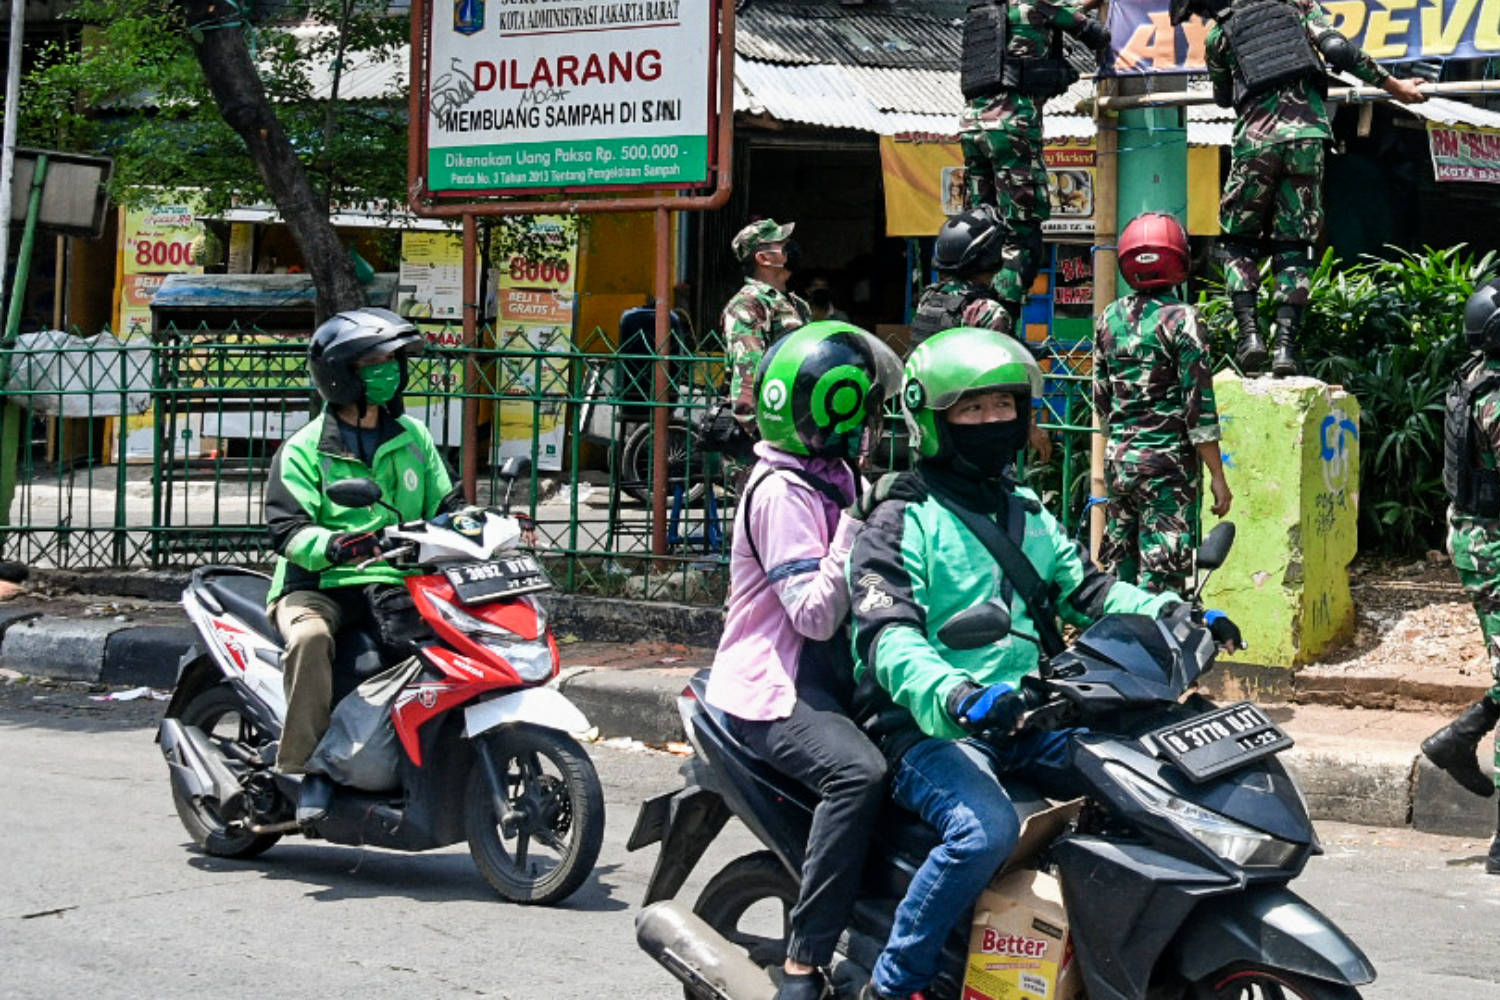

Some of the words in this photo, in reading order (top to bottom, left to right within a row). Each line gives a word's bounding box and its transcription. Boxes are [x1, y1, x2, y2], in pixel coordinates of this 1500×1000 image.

[499, 10, 526, 31] KOTA
[527, 6, 598, 29] ADMINISTRASI
[599, 2, 645, 25] JAKARTA
[646, 0, 681, 22] BARAT
[473, 49, 662, 92] DILARANG
[445, 105, 540, 133] MEMBUANG
[544, 102, 615, 128] SAMPAH
[619, 101, 637, 124] DI
[642, 99, 682, 124] SINI
[445, 151, 512, 168] Dikenakan
[516, 148, 550, 168] Uang
[555, 146, 593, 164] Paksa
[596, 146, 616, 165] Rp.
[500, 170, 527, 184] Tahun
[551, 166, 587, 185] Tentang
[644, 162, 681, 181] Sampah
[1438, 166, 1475, 179] KOTA
[1167, 735, 1190, 752] B
[981, 928, 1047, 958] Better
